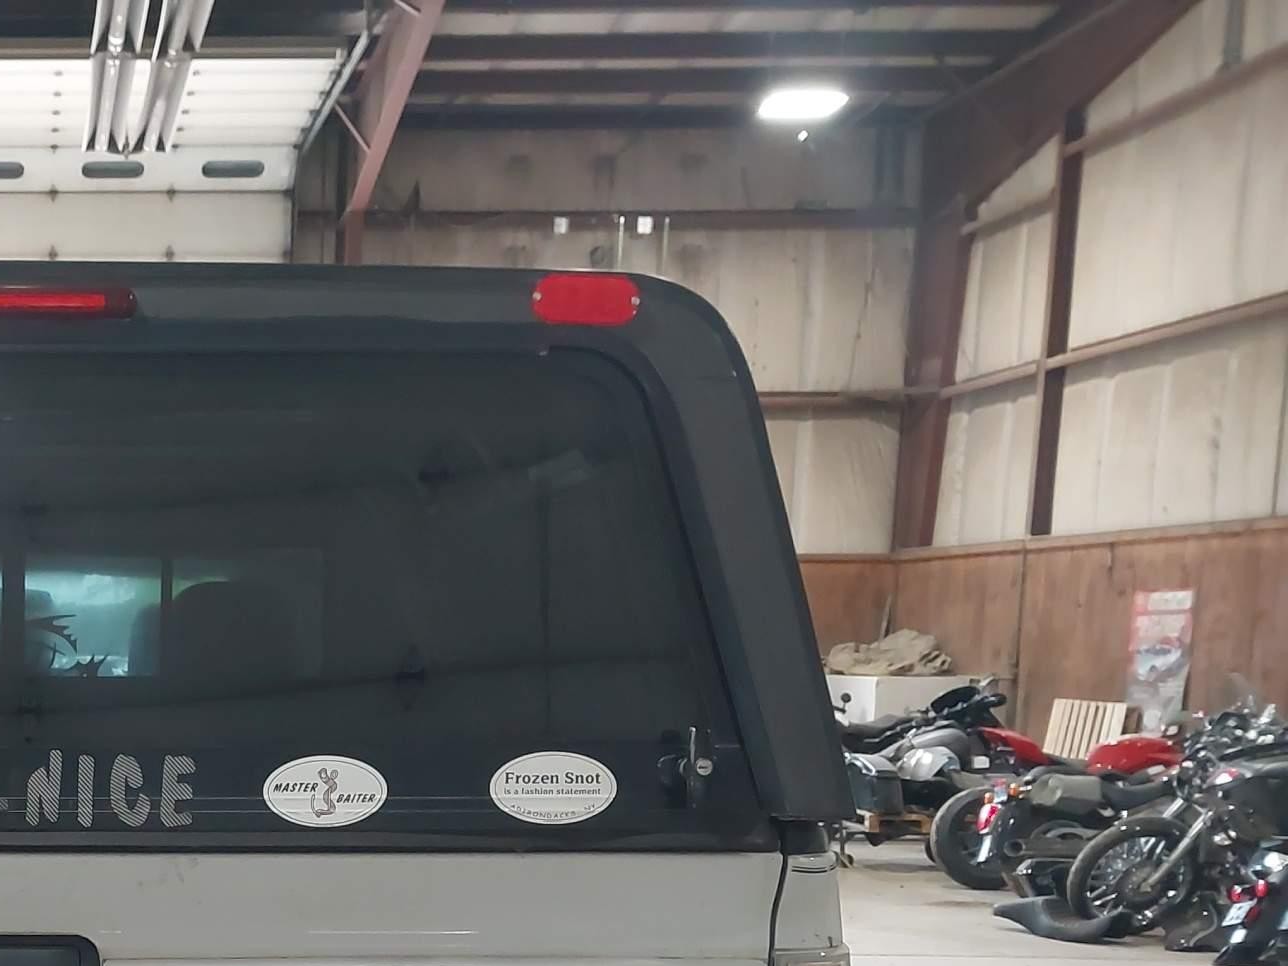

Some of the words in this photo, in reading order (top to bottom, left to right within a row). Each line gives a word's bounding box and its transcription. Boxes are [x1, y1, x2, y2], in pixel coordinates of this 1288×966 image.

[504, 771, 560, 785] Frozen
[564, 771, 601, 785] Snot
[273, 782, 319, 793] MASTER
[503, 787, 511, 796] is
[513, 788, 519, 796] a
[521, 787, 554, 796] fashion
[556, 787, 601, 796] statement
[336, 793, 376, 804] BAITER
